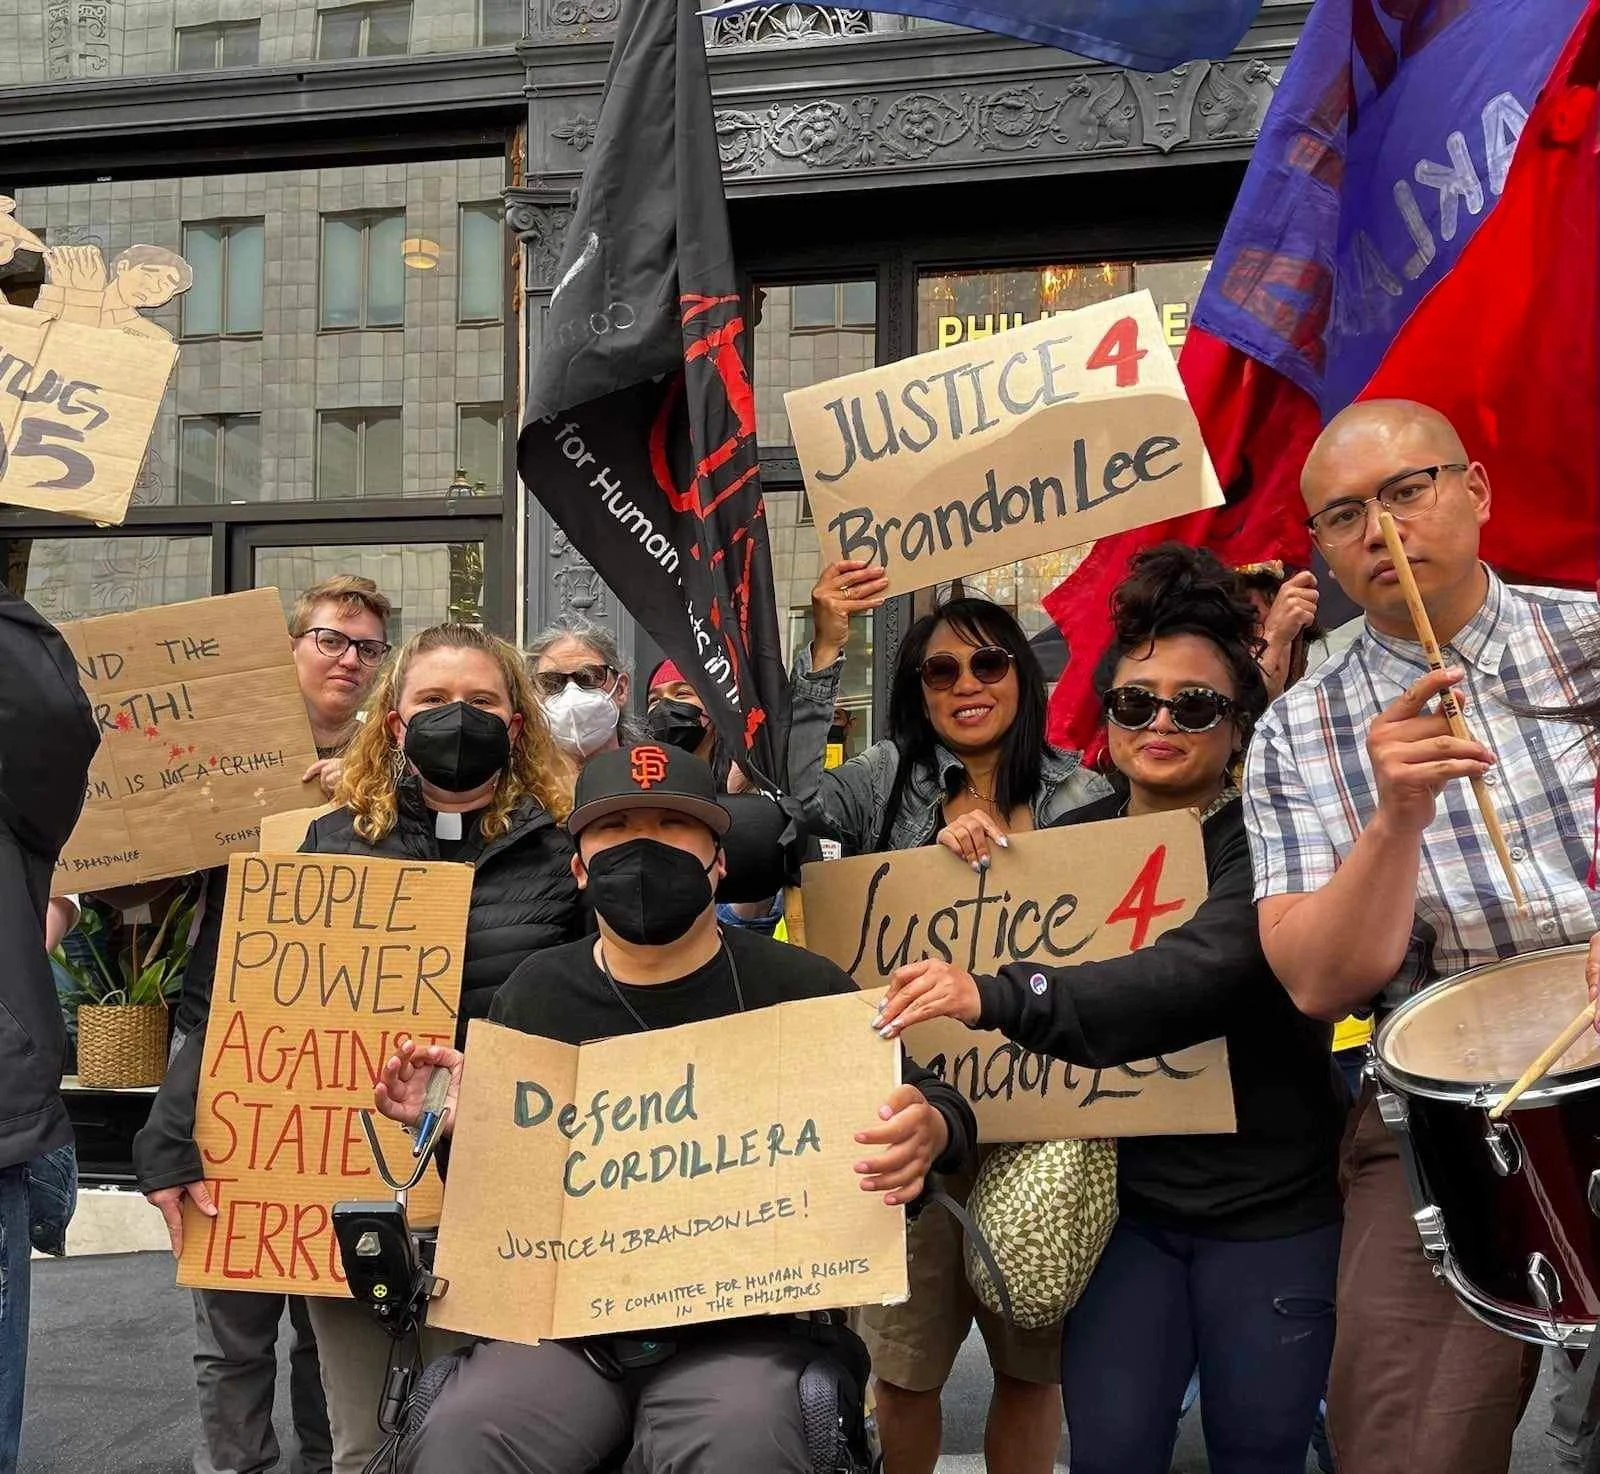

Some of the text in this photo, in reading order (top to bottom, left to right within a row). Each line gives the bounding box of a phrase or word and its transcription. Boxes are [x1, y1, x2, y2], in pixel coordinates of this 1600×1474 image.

[815, 335, 1079, 482] JUSTICE
[1085, 316, 1148, 387] 4
[554, 421, 682, 574] for Human
[156, 633, 220, 664] THE
[95, 683, 194, 734] RTH!
[125, 775, 145, 794] IS
[196, 763, 209, 780] A
[219, 751, 285, 776] CRIME!
[238, 857, 427, 932] PEOPLE
[846, 844, 1186, 977] Justice 4
[228, 930, 457, 1018] POWER
[203, 1091, 376, 1177] STATE
[513, 1063, 698, 1145] Defend
[563, 1119, 821, 1198] CORDILLERA
[497, 1229, 598, 1262] JUSTICE
[590, 1258, 870, 1319] SF COMMITTEE FOR HUMAN RIGHTS
[676, 1304, 693, 1318] IN
[706, 1294, 735, 1314] THE
